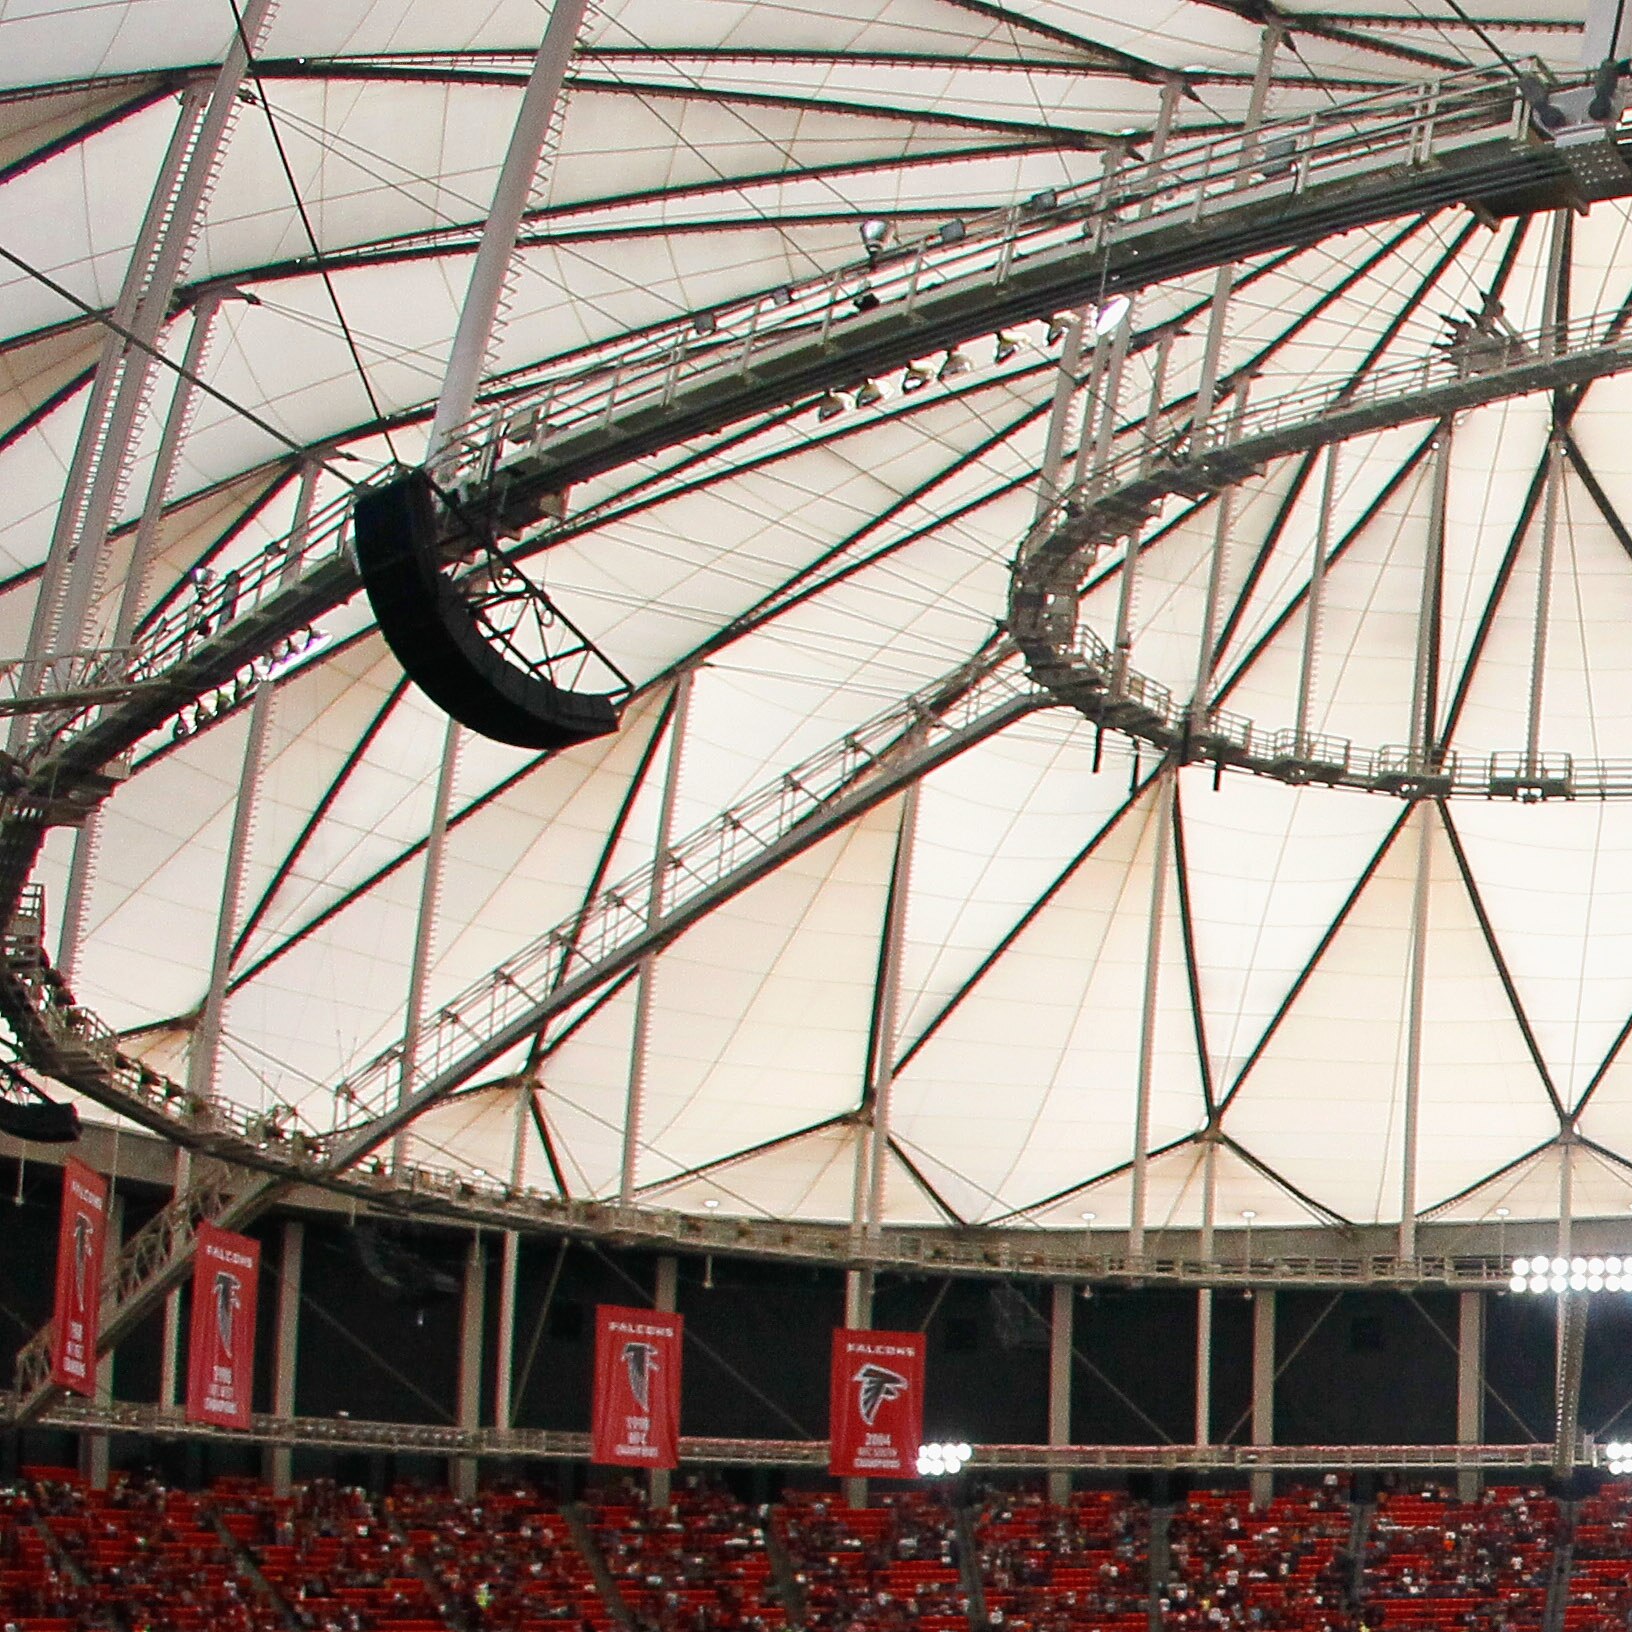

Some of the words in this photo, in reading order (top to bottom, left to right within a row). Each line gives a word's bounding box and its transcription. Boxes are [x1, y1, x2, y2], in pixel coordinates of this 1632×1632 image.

[207, 1245, 253, 1268] FALCONS
[609, 1321, 674, 1337] FALCONS
[846, 1342, 916, 1357] FALCONS
